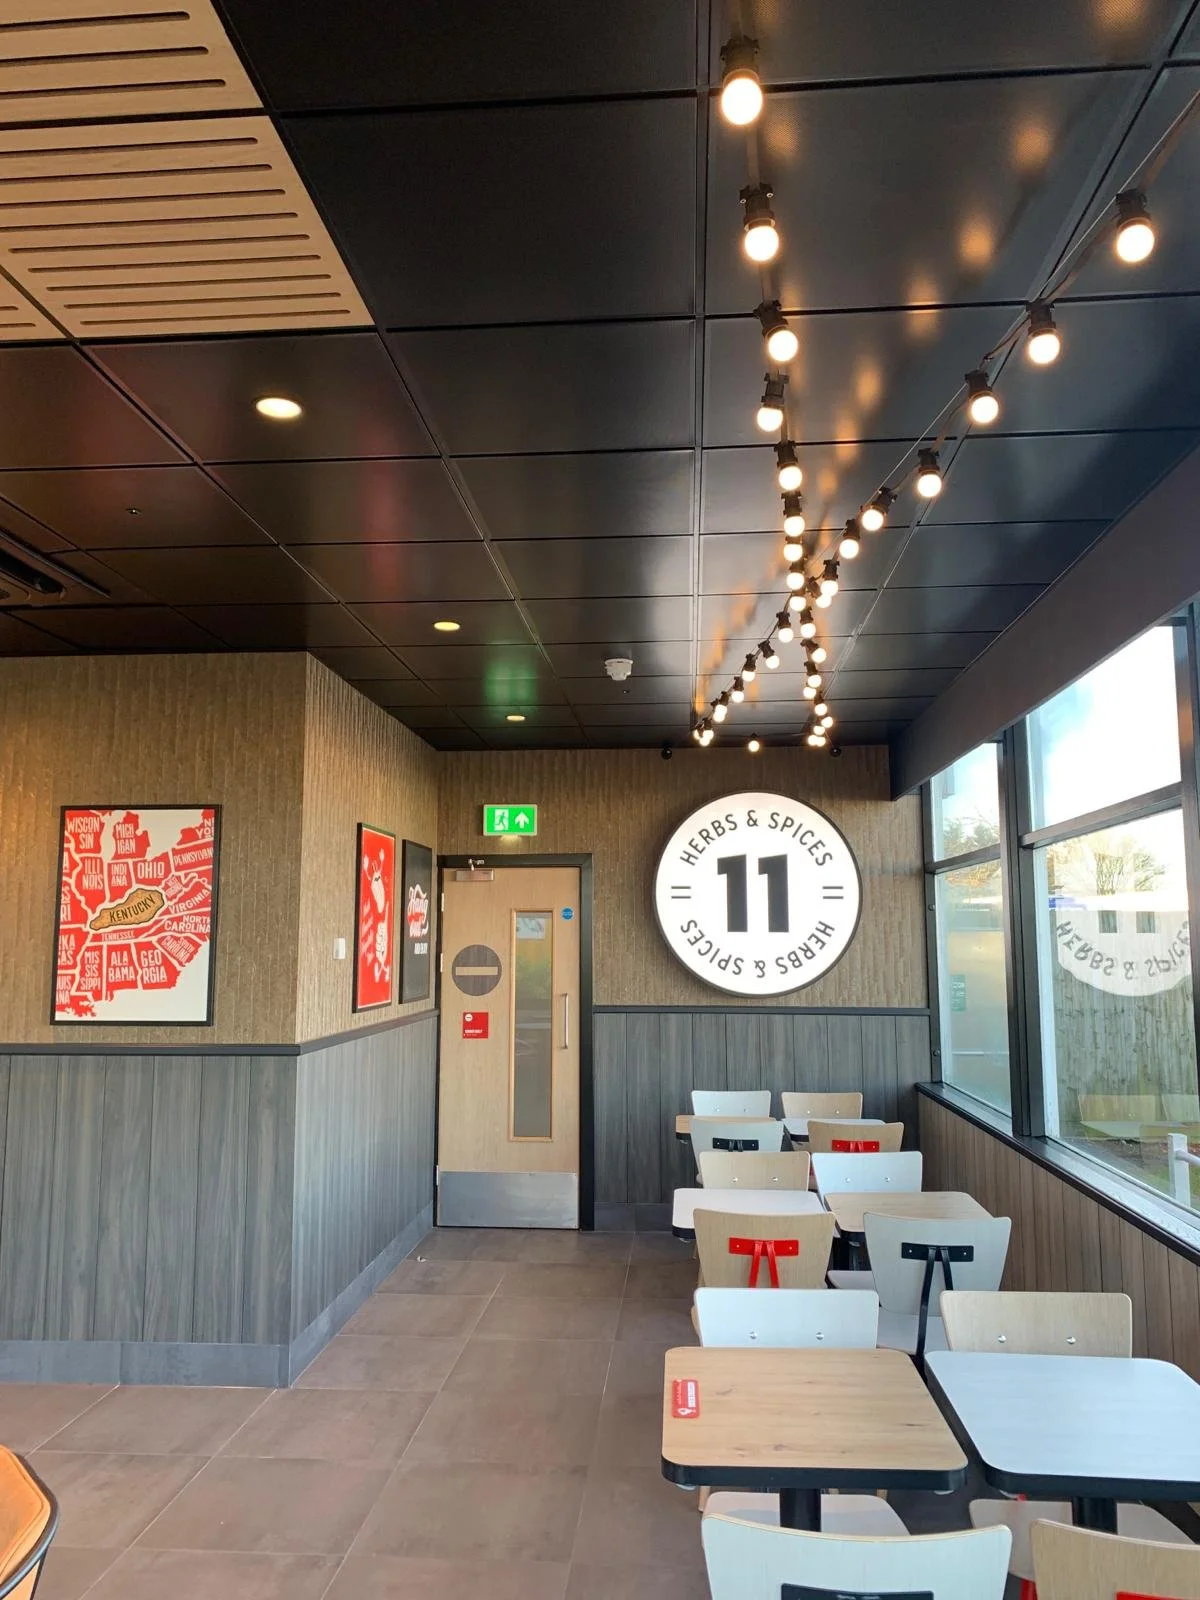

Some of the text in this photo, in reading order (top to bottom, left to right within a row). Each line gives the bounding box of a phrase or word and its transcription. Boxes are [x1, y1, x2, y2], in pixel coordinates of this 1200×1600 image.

[67, 816, 99, 834] WISCON
[116, 823, 134, 839] MICH
[79, 833, 94, 850] SIN
[117, 838, 136, 855] IGAN
[680, 809, 833, 867] HERBS & SPICES
[84, 858, 101, 875] ILLI
[111, 863, 127, 875] INDI
[137, 861, 165, 879] OHIO
[83, 874, 104, 890] NOIS
[111, 875, 128, 887] ANA
[168, 888, 211, 914] VIRGINIA
[717, 854, 789, 933] 11
[109, 894, 156, 923] KENTUCKY
[164, 920, 211, 933] CAROLINA
[101, 930, 136, 942] TENNESSEE
[680, 919, 835, 978] HERBS & SPICES
[84, 951, 100, 965] MIS
[111, 951, 128, 966] ALA
[140, 949, 162, 967] GEO
[85, 964, 99, 978] SIS
[108, 966, 135, 983] BAMA
[142, 966, 168, 984] RGIA
[80, 977, 101, 991] SIPPI
